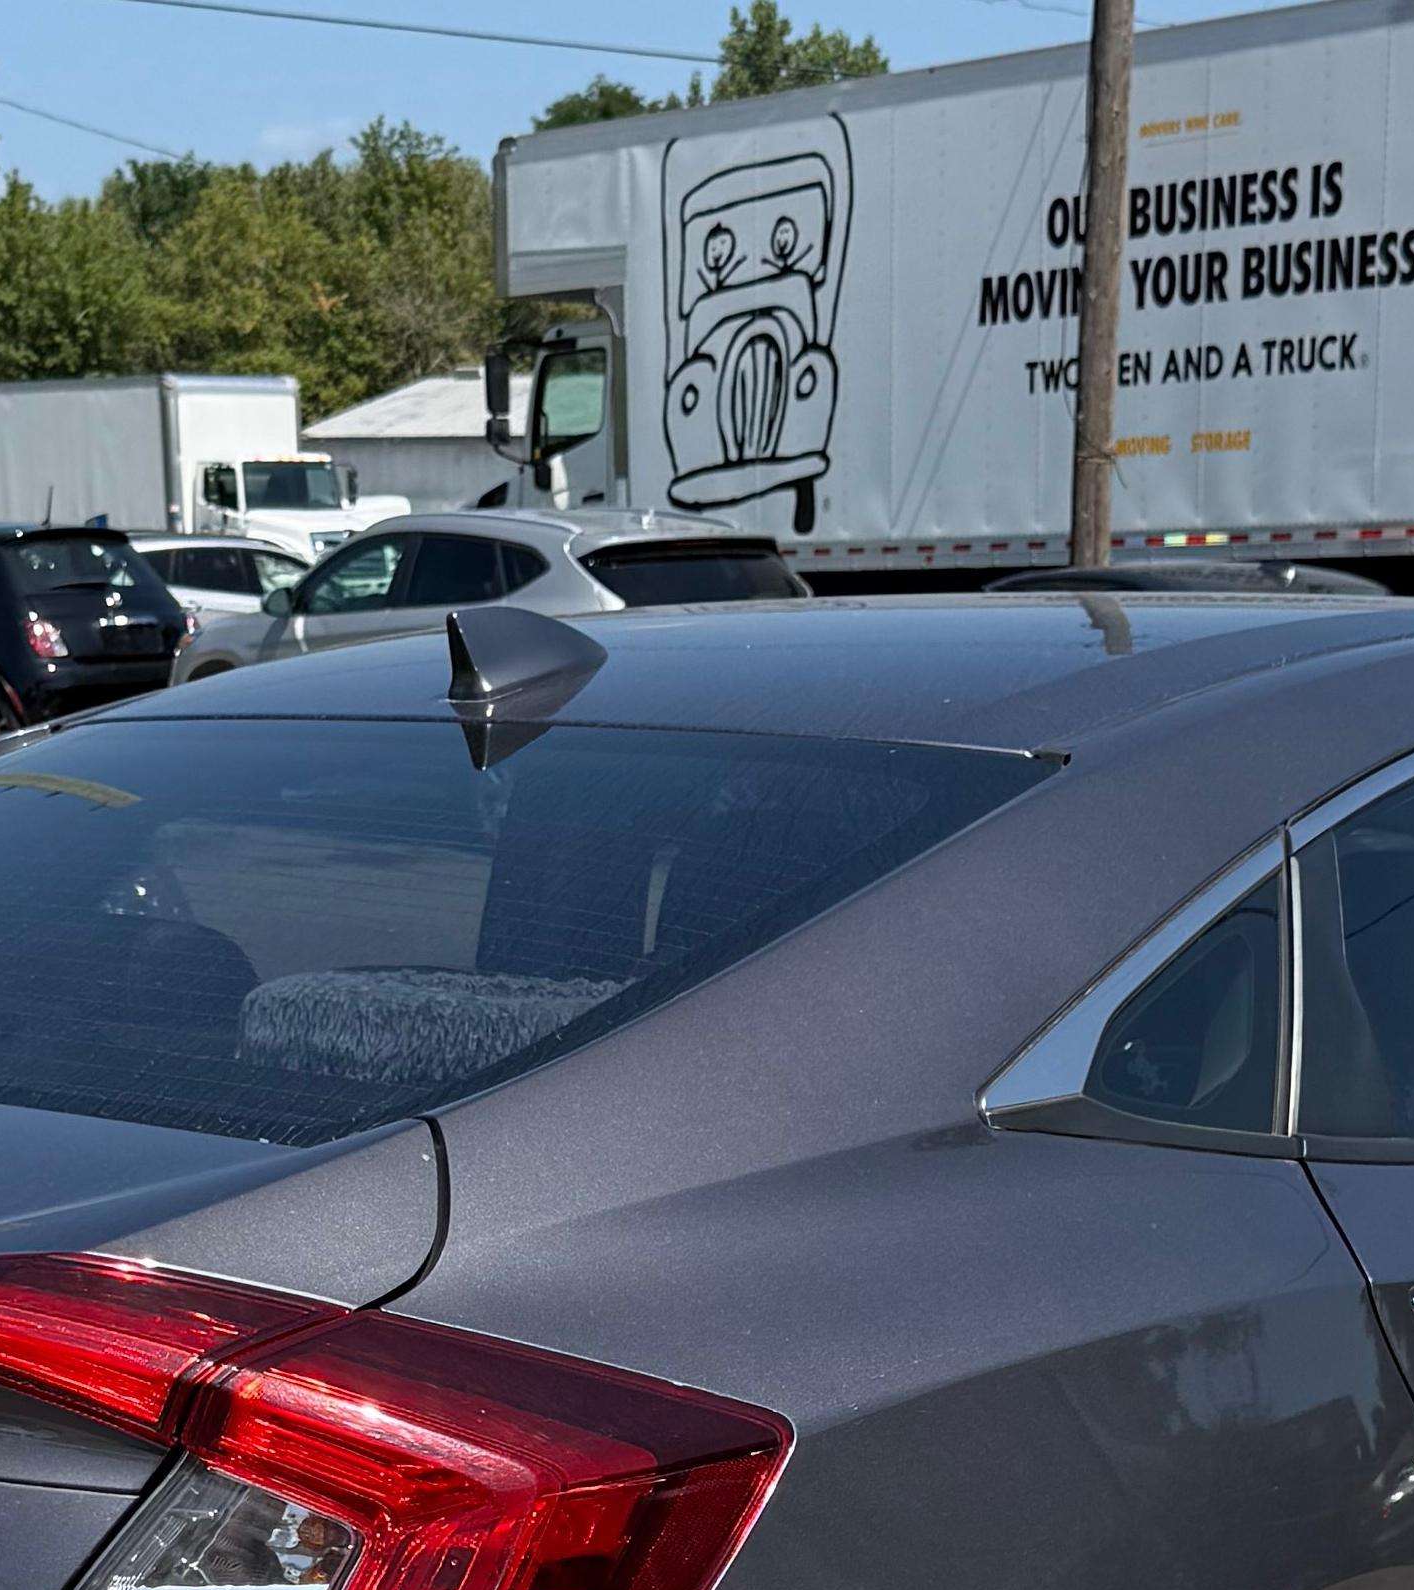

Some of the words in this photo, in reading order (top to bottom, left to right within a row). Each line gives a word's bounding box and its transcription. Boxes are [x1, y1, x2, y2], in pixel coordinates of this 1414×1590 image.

[1047, 195, 1088, 248] OU
[1129, 167, 1298, 239] BUSINESS
[1310, 161, 1343, 218] IS
[978, 267, 1085, 327] MOVIN
[1130, 250, 1228, 310] YOUR
[1117, 351, 1152, 386] EN
[1160, 344, 1223, 383] AND
[1232, 342, 1252, 379] A
[1262, 331, 1357, 376] TRUCK
[1191, 429, 1250, 453] STORAGE
